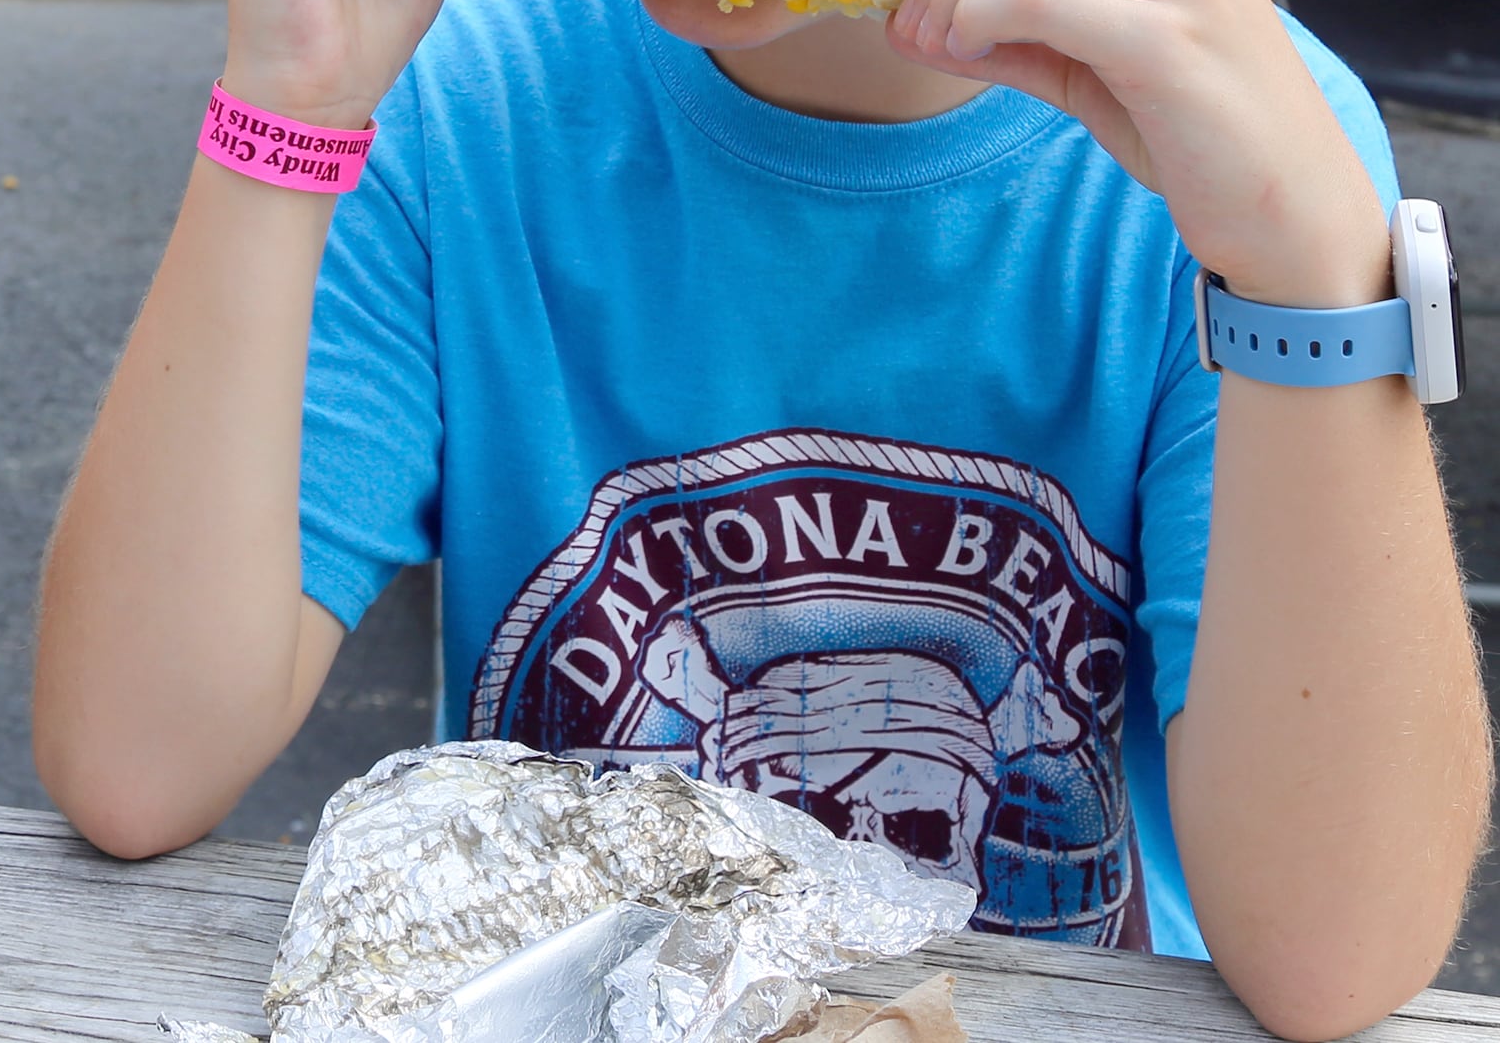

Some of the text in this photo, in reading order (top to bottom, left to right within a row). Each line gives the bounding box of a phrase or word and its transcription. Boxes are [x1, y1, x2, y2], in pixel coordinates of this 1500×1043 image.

[209, 123, 341, 182] Windy City
[228, 109, 373, 158] Amusements
[549, 493, 910, 707] DAYTONA
